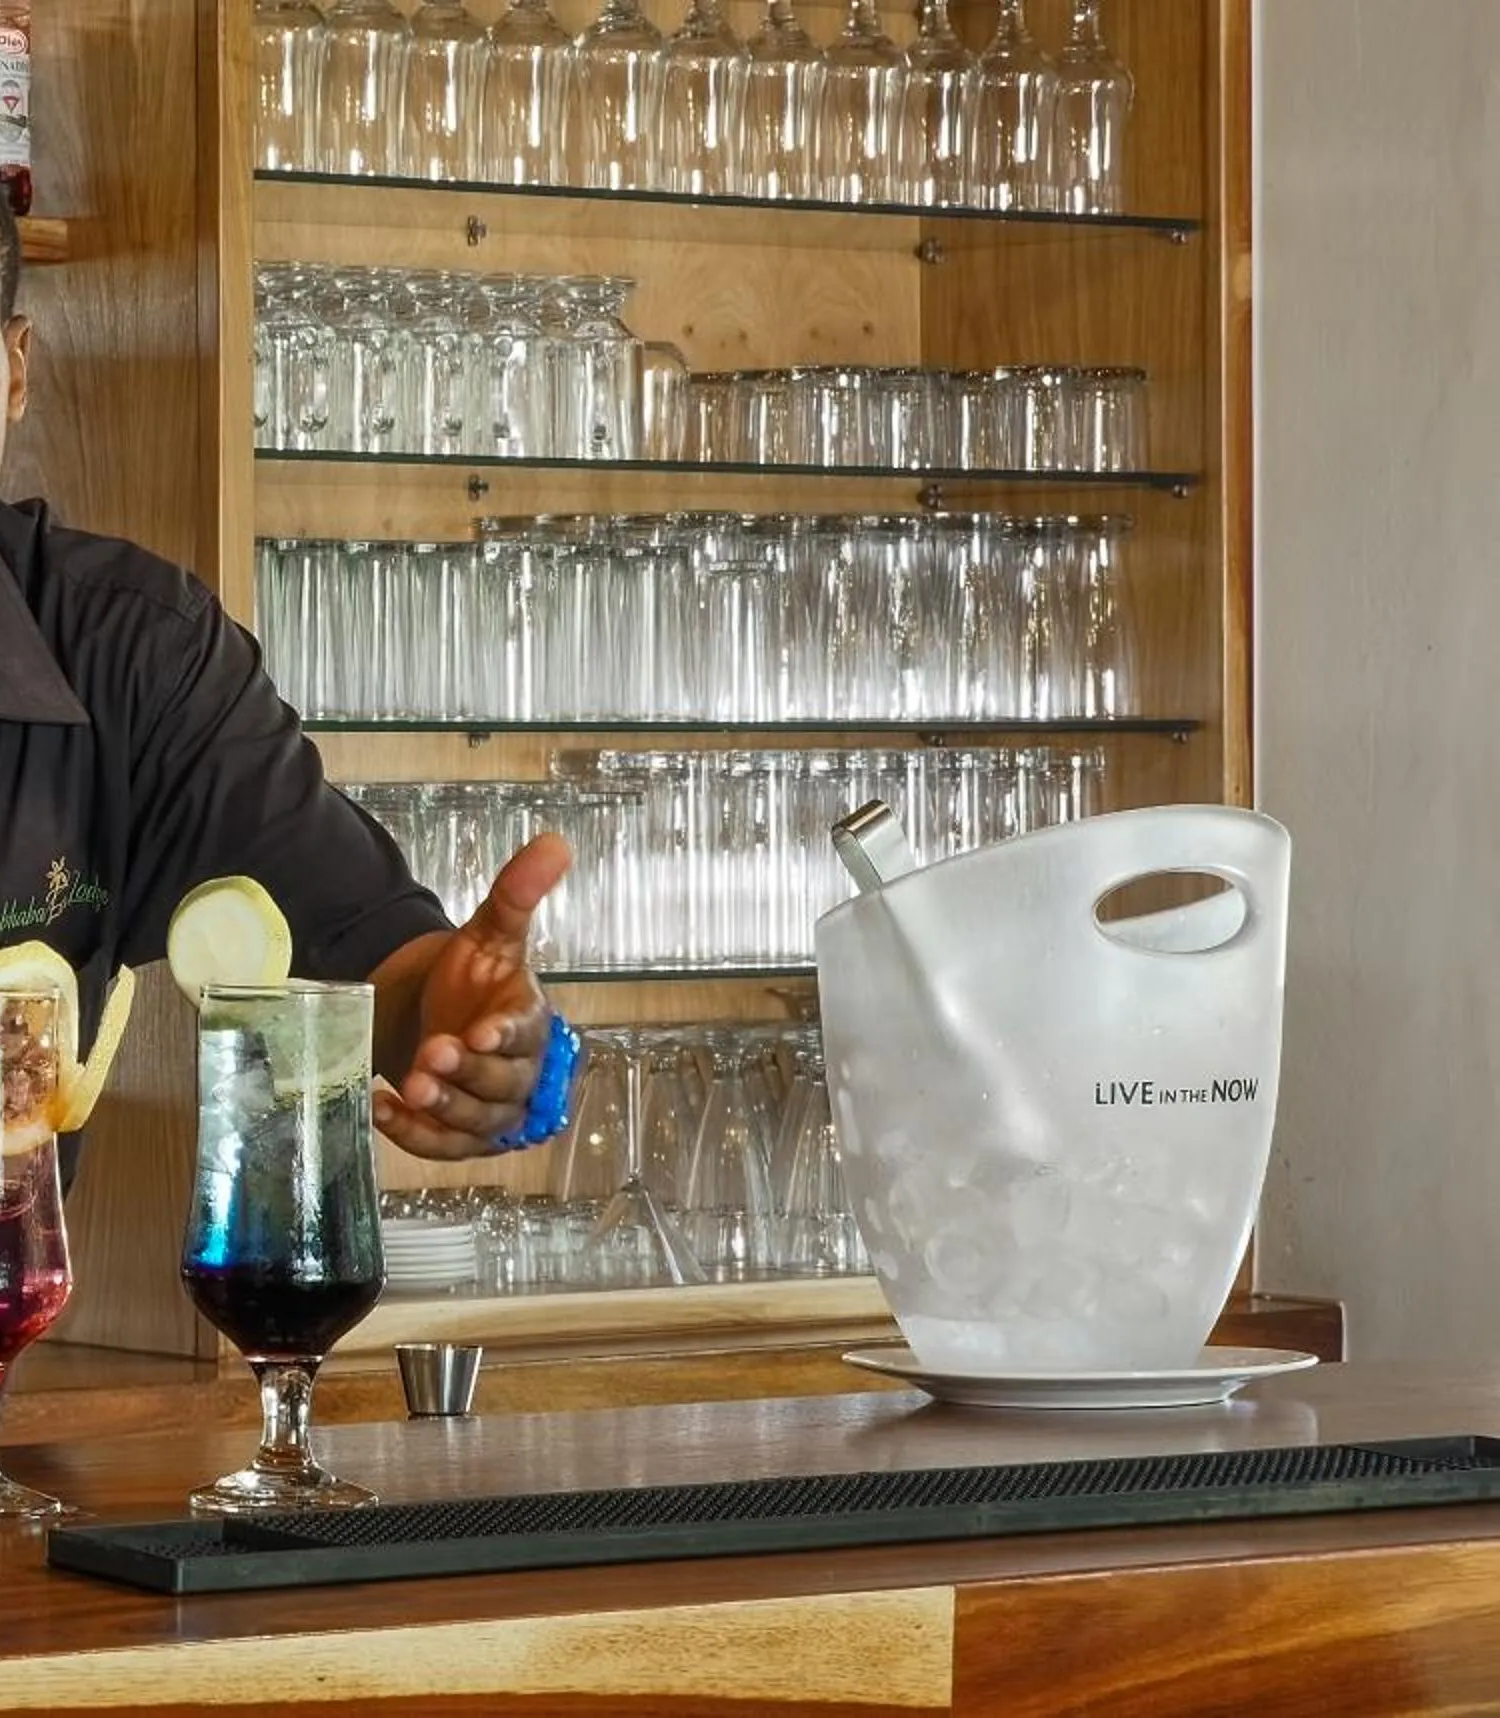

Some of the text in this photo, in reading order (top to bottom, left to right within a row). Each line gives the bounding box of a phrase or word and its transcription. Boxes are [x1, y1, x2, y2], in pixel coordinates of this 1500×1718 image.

[1095, 1077, 1259, 1105] LIVE IN THE NOW
